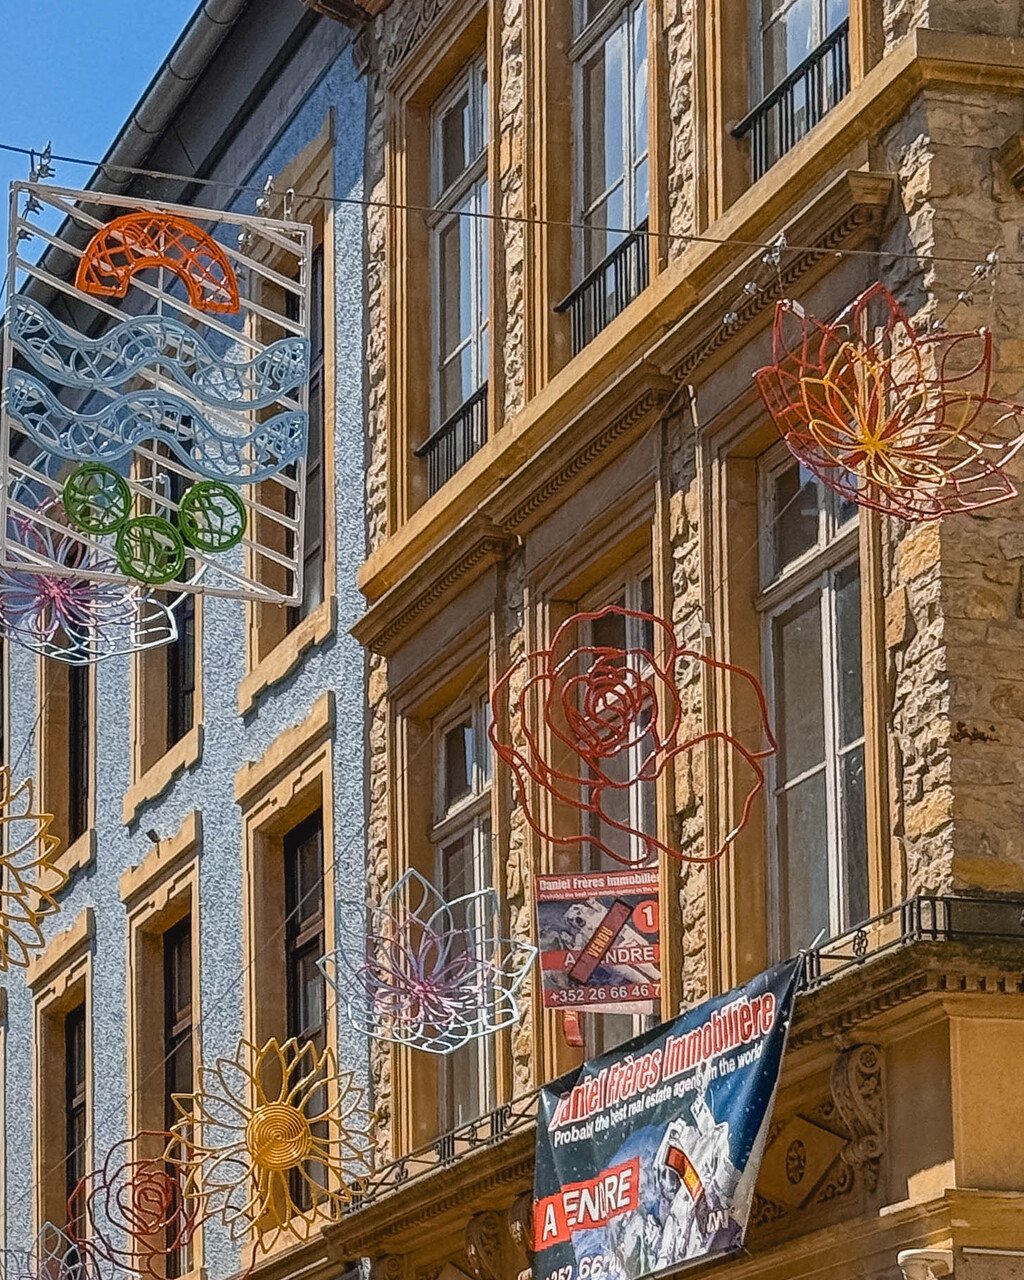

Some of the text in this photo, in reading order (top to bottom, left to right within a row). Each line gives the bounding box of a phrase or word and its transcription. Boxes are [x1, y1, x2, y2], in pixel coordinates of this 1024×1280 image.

[587, 925, 614, 958] VENDU
[600, 946, 655, 965] NDRE
[550, 988, 585, 1003] +352
[588, 987, 607, 1001] 26
[610, 985, 628, 999] 66
[632, 984, 649, 998] 46
[606, 1048, 663, 1109] Frères
[662, 991, 777, 1081] Immobilière
[595, 1114, 610, 1133] the
[628, 1094, 645, 1117] real
[645, 1083, 672, 1110] estate
[673, 1069, 705, 1099] agenc
[718, 1056, 736, 1077] the
[736, 1039, 764, 1069] world
[542, 1167, 633, 1241] A ENDRE
